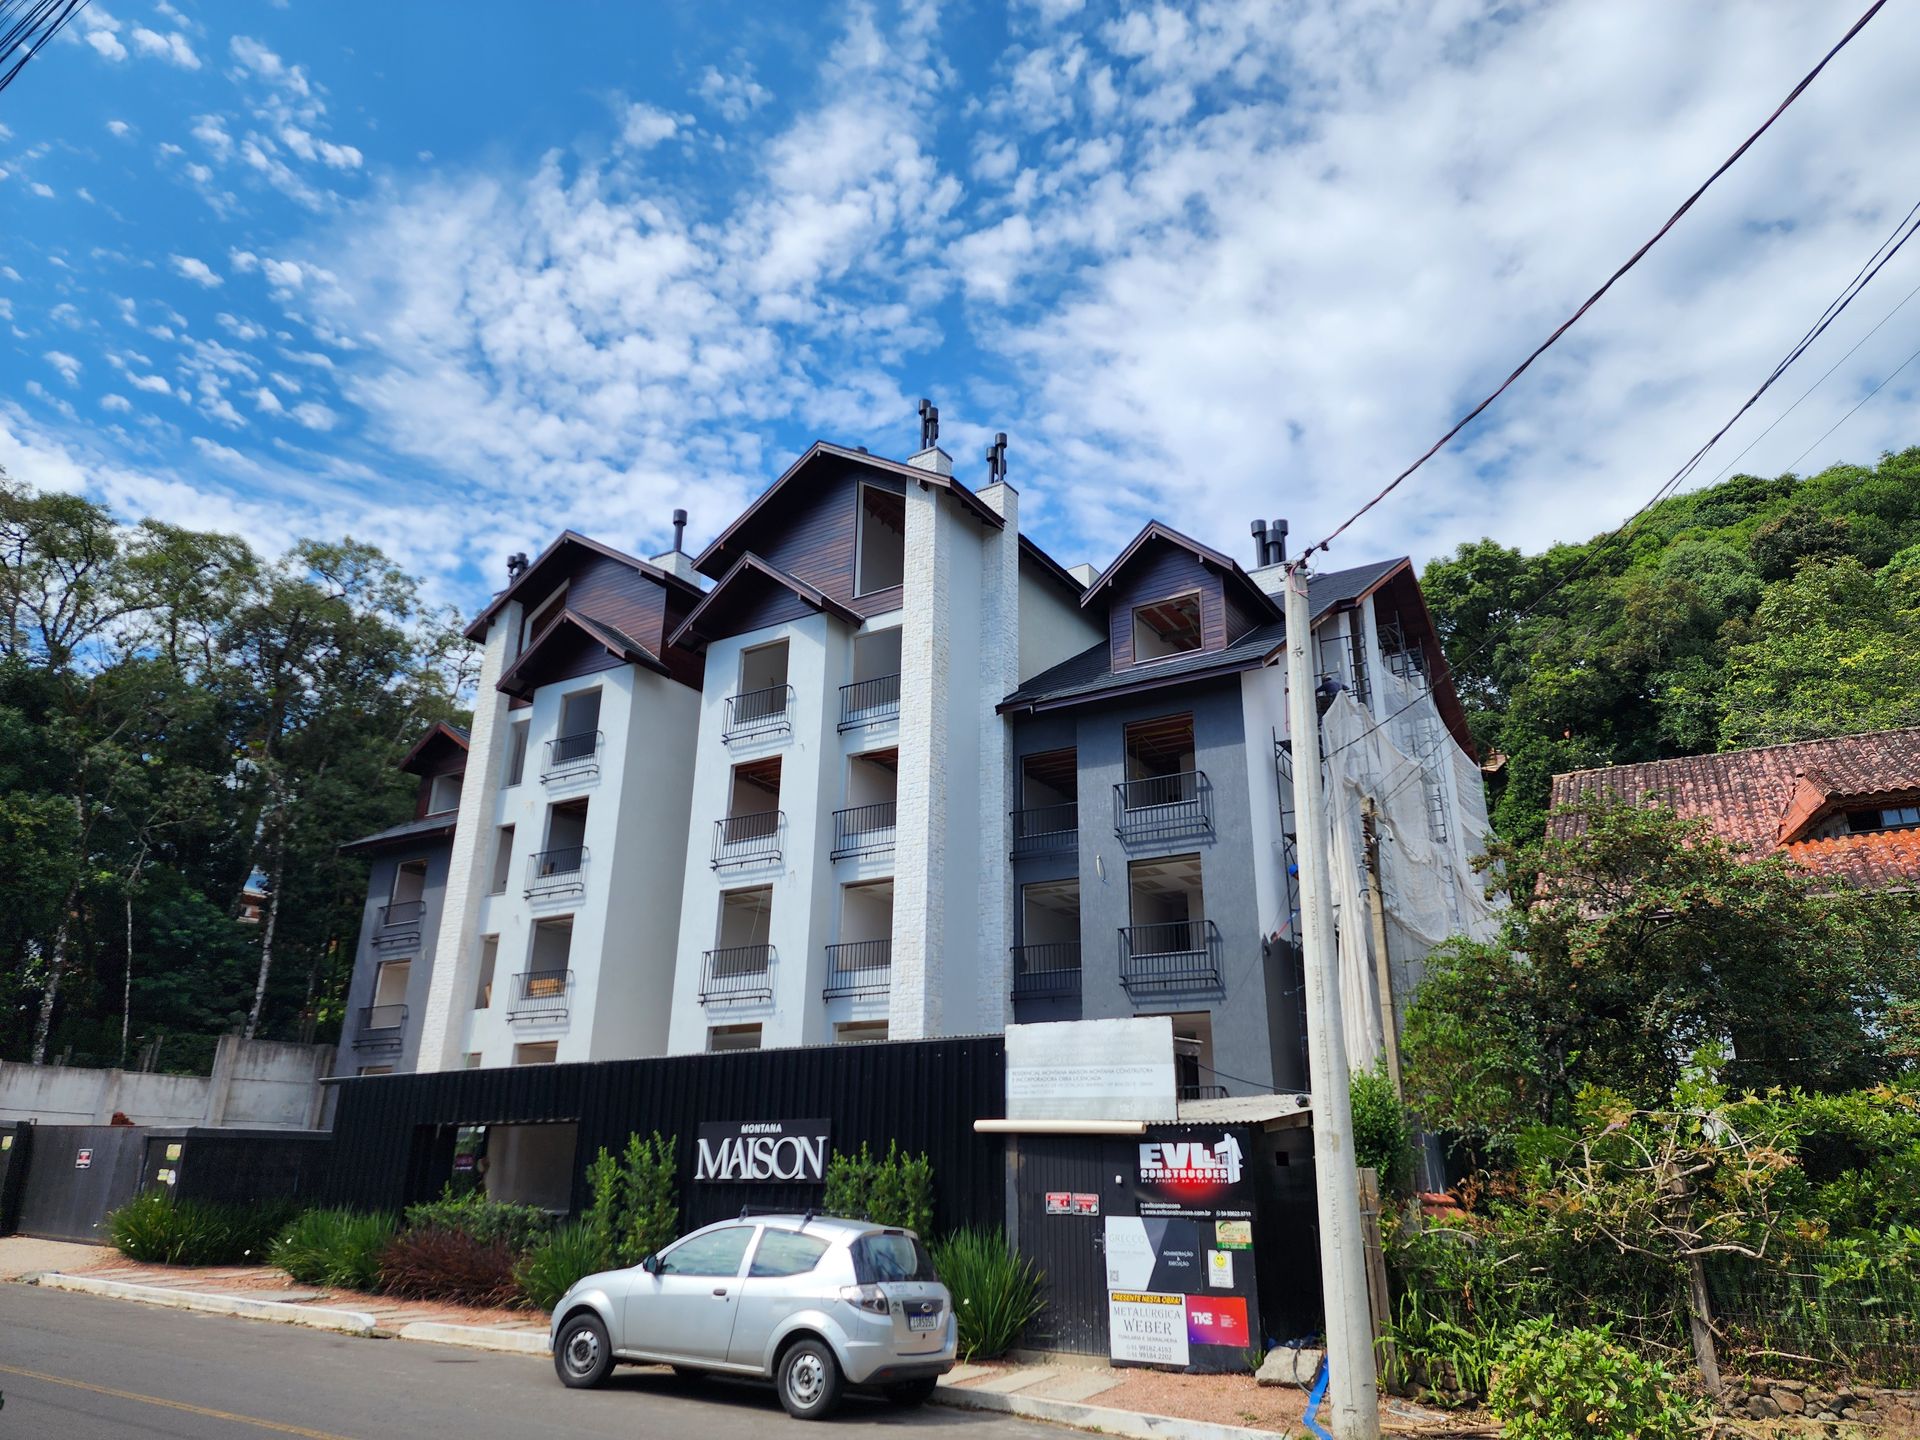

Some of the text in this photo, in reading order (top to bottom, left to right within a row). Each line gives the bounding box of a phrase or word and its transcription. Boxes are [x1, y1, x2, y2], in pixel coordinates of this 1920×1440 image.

[741, 1123, 782, 1134] MONTANA
[694, 1136, 828, 1180] MAISON
[1140, 1169, 1228, 1180] CONSTRUÇÕES
[1112, 1293, 1141, 1302] PRESENTE
[1141, 1294, 1161, 1303] NESTA
[1123, 1318, 1172, 1336] WEBER
